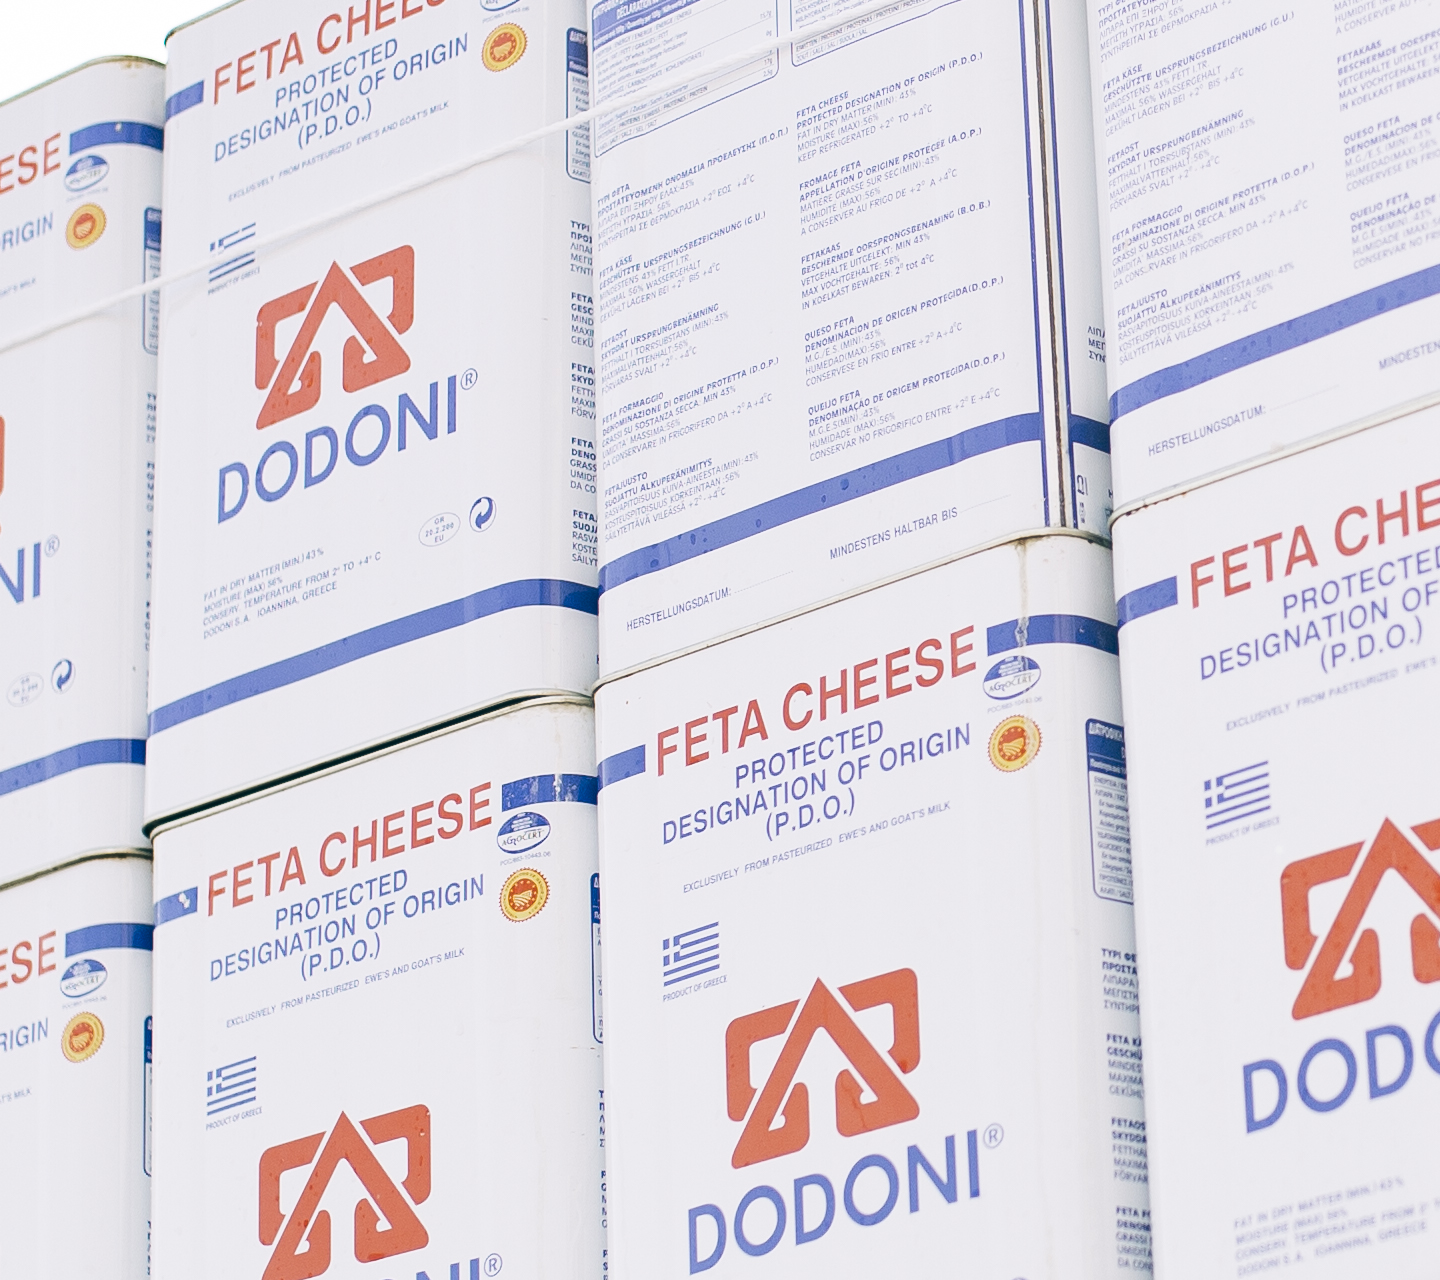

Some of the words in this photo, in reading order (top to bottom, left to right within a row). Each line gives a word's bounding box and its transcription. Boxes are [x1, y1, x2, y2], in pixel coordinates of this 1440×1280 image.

[214, 32, 303, 105] FETA
[215, 84, 349, 162] DESIGNATION
[358, 67, 386, 104] OF
[393, 32, 467, 82] ORIGIN
[276, 37, 397, 108] PROTECTED
[298, 99, 371, 149] (P.D.O.)
[830, 529, 891, 560] MINDESTENS
[894, 513, 938, 538] HALTBAR
[942, 507, 958, 522] BIS
[1191, 524, 1318, 609] FETA
[627, 587, 731, 631] HERSTELLUNGSDATUM:
[1201, 596, 1388, 681] DESIGNATION
[1402, 580, 1438, 613] OF
[1321, 616, 1422, 673] (P.D.O.)
[658, 699, 768, 777] FETA
[783, 625, 976, 732] CHEESE
[663, 769, 826, 845] DESIGNATION
[838, 754, 870, 795] OF
[880, 724, 969, 772] ORIGIN
[736, 720, 883, 789] PROTECTED
[208, 846, 305, 916] FETA
[319, 781, 492, 878] CHEESE
[766, 787, 854, 842] (P.D.O.)
[211, 914, 355, 982] DESIGNATION
[366, 901, 395, 938] OF
[403, 873, 483, 919] ORIGIN
[276, 868, 408, 930] PROTECTED
[301, 933, 380, 981] (P.D.O.)
